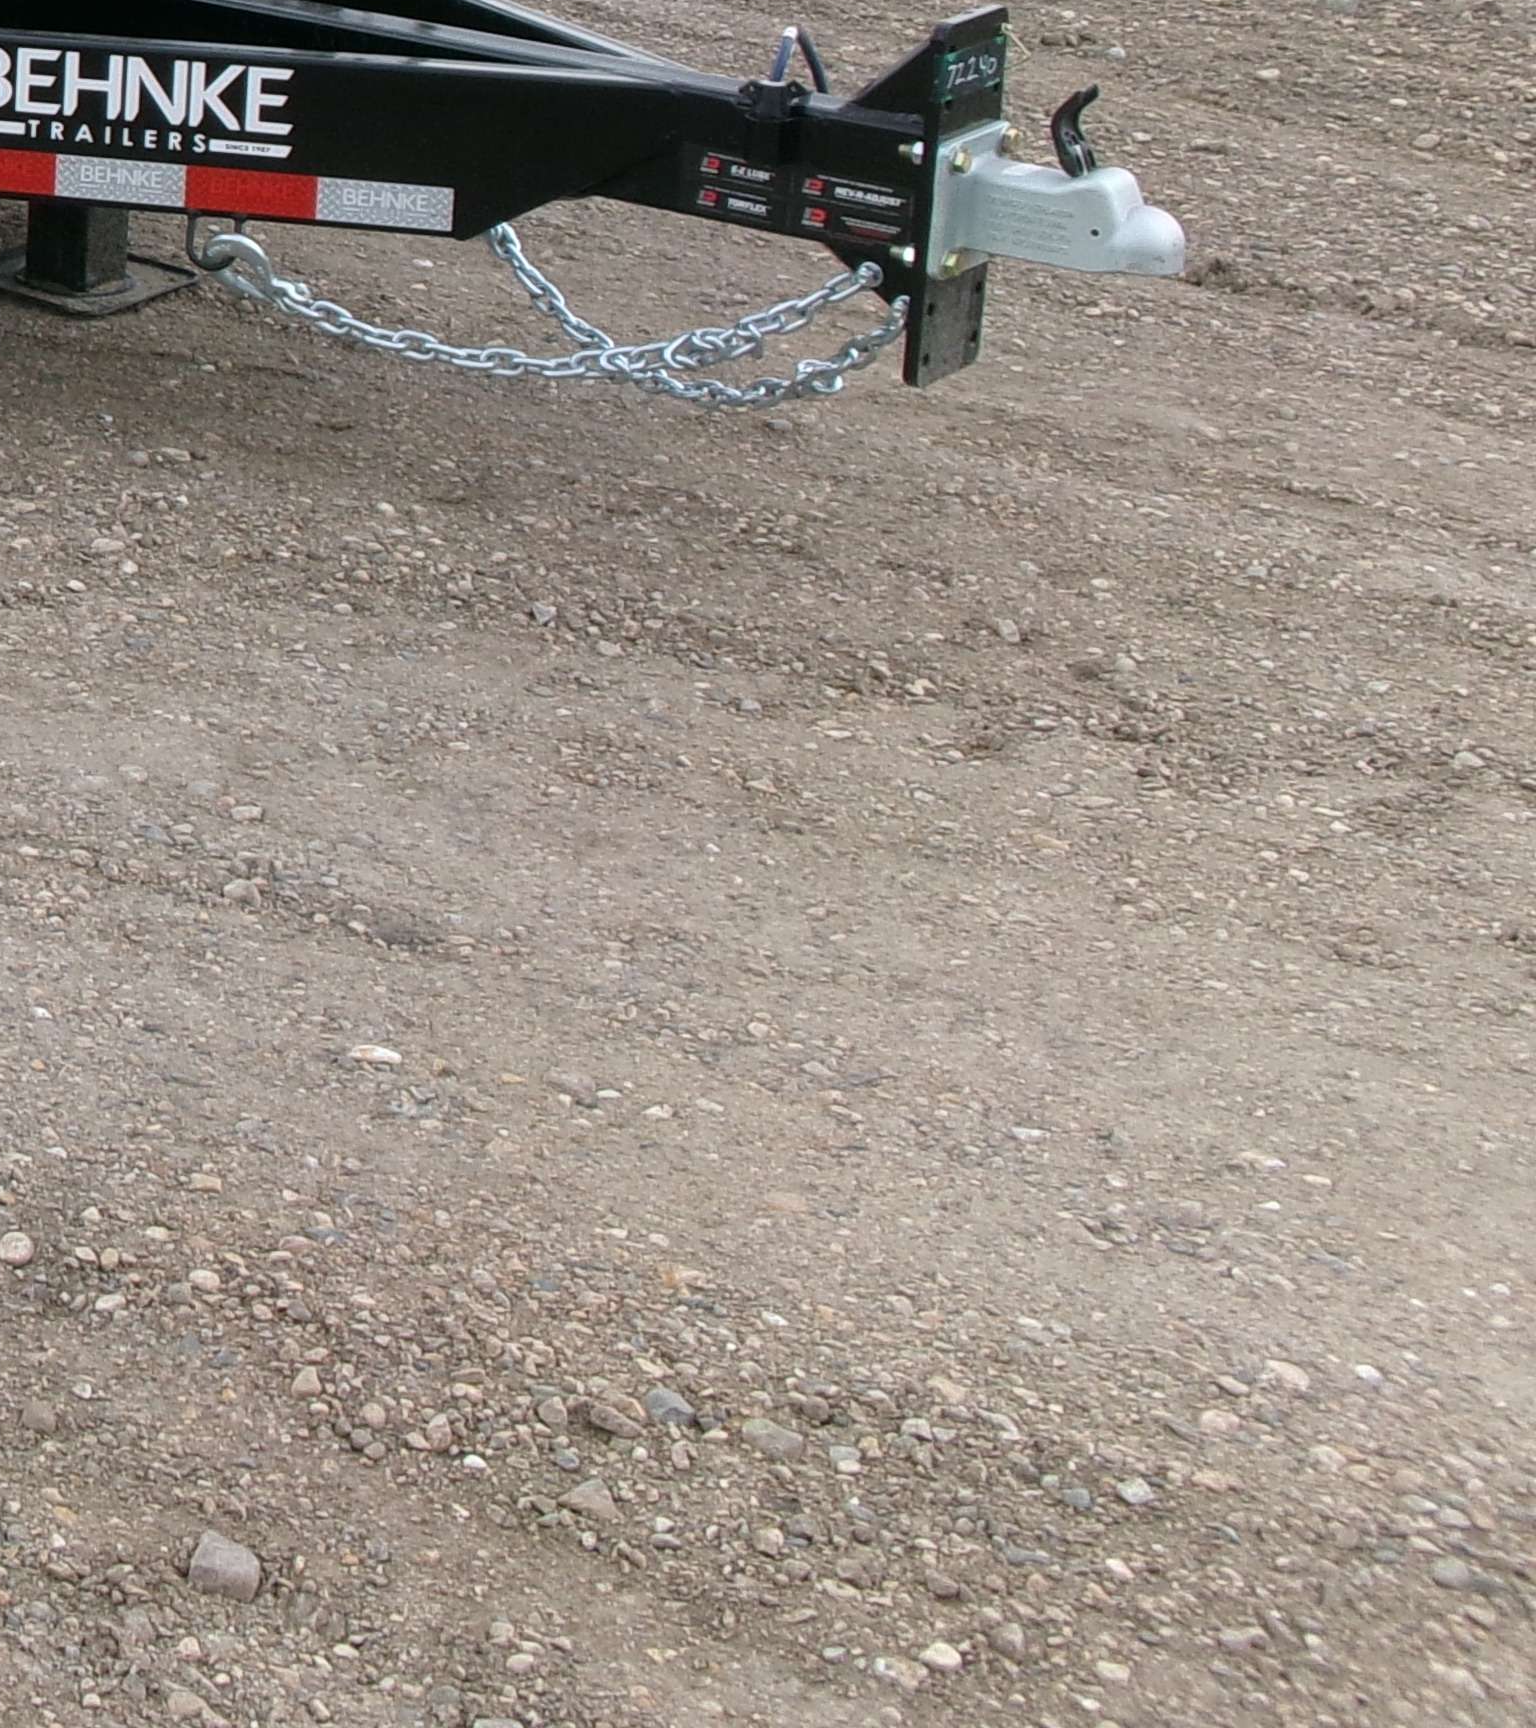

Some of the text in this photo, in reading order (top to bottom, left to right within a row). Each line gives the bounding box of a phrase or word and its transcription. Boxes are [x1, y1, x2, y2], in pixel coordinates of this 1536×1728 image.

[28, 119, 207, 154] TRAILERS
[80, 162, 163, 190] BEHNKE
[341, 187, 429, 213] BEHNKE
